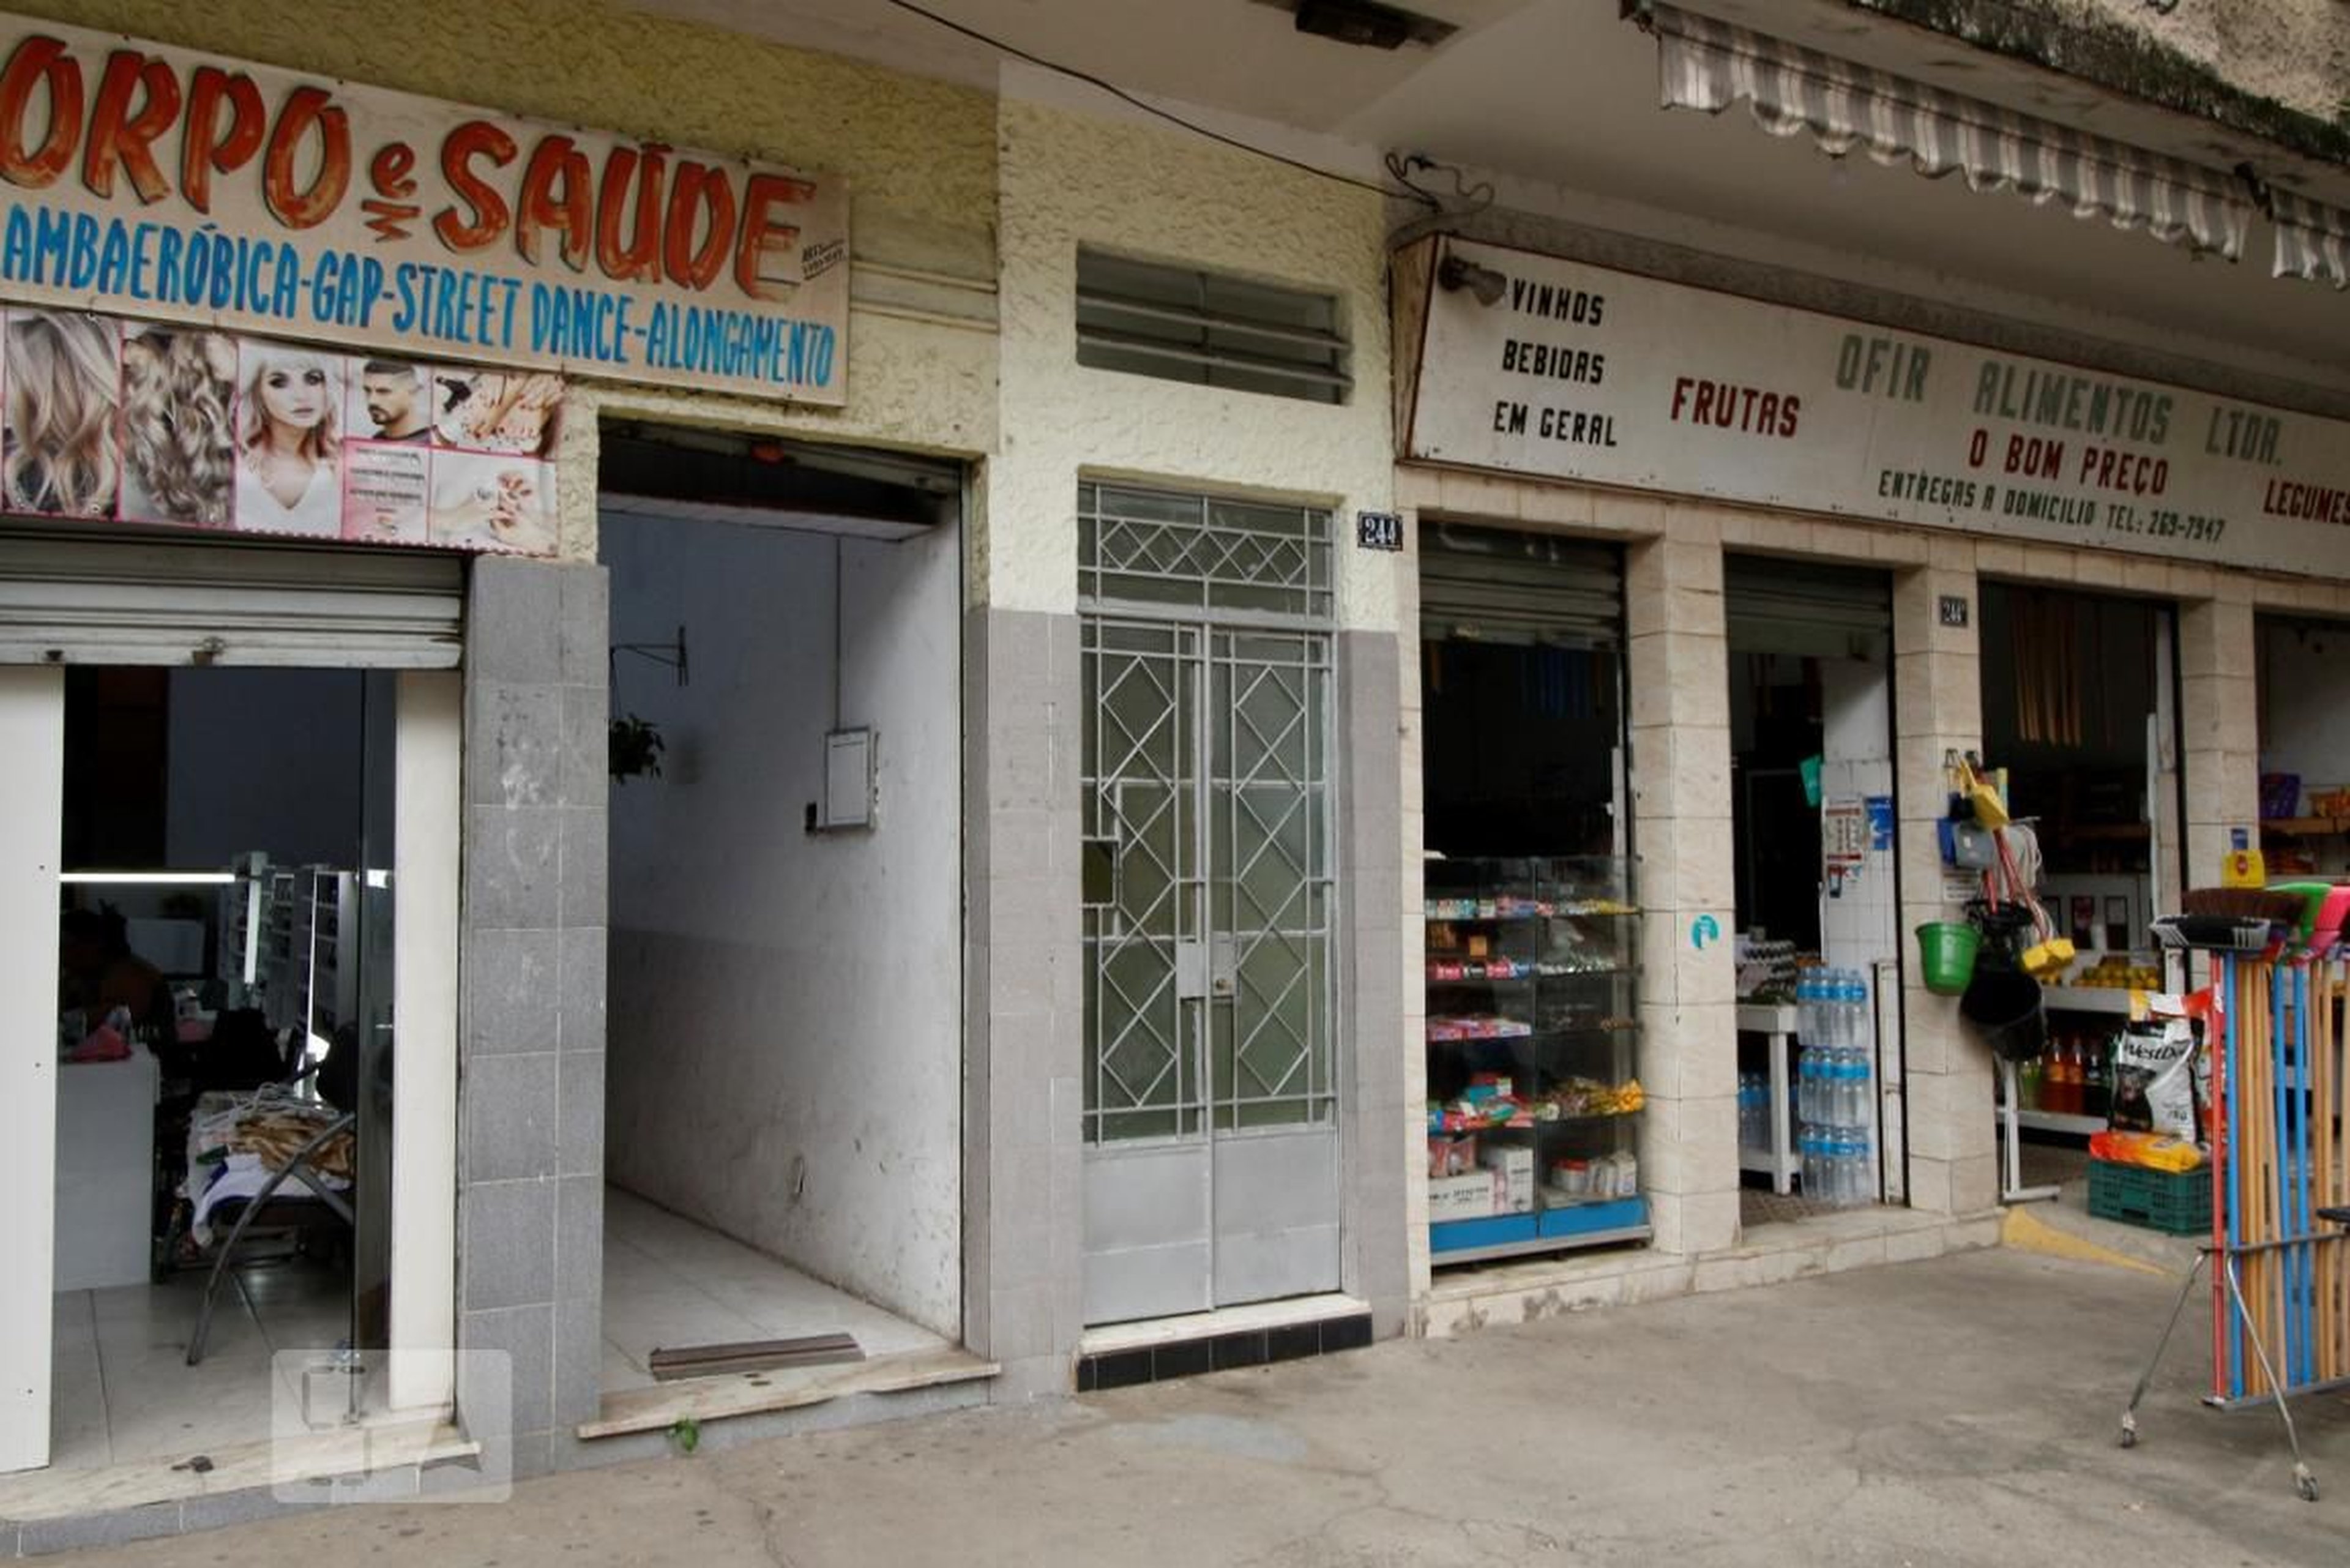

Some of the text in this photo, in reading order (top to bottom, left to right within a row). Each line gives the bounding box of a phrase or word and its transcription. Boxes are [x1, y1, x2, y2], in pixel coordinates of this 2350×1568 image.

[431, 119, 817, 304] SAÚDE
[1512, 277, 1605, 327] VINHOS
[1502, 339, 1605, 385] BEBIDAS
[1493, 401, 1617, 447] EM GERAL
[1671, 376, 1800, 438] FRUTAS
[1836, 334, 2283, 466] OFIR ALIMENTOS LTDA.
[1969, 428, 2169, 496] O BOM PREÇO
[1365, 517, 1397, 544] 244
[1878, 469, 1976, 508] ENTREGAS
[1981, 485, 1996, 511] A
[2003, 488, 2095, 526] DOMICILIO
[2106, 504, 2143, 534] TEL:
